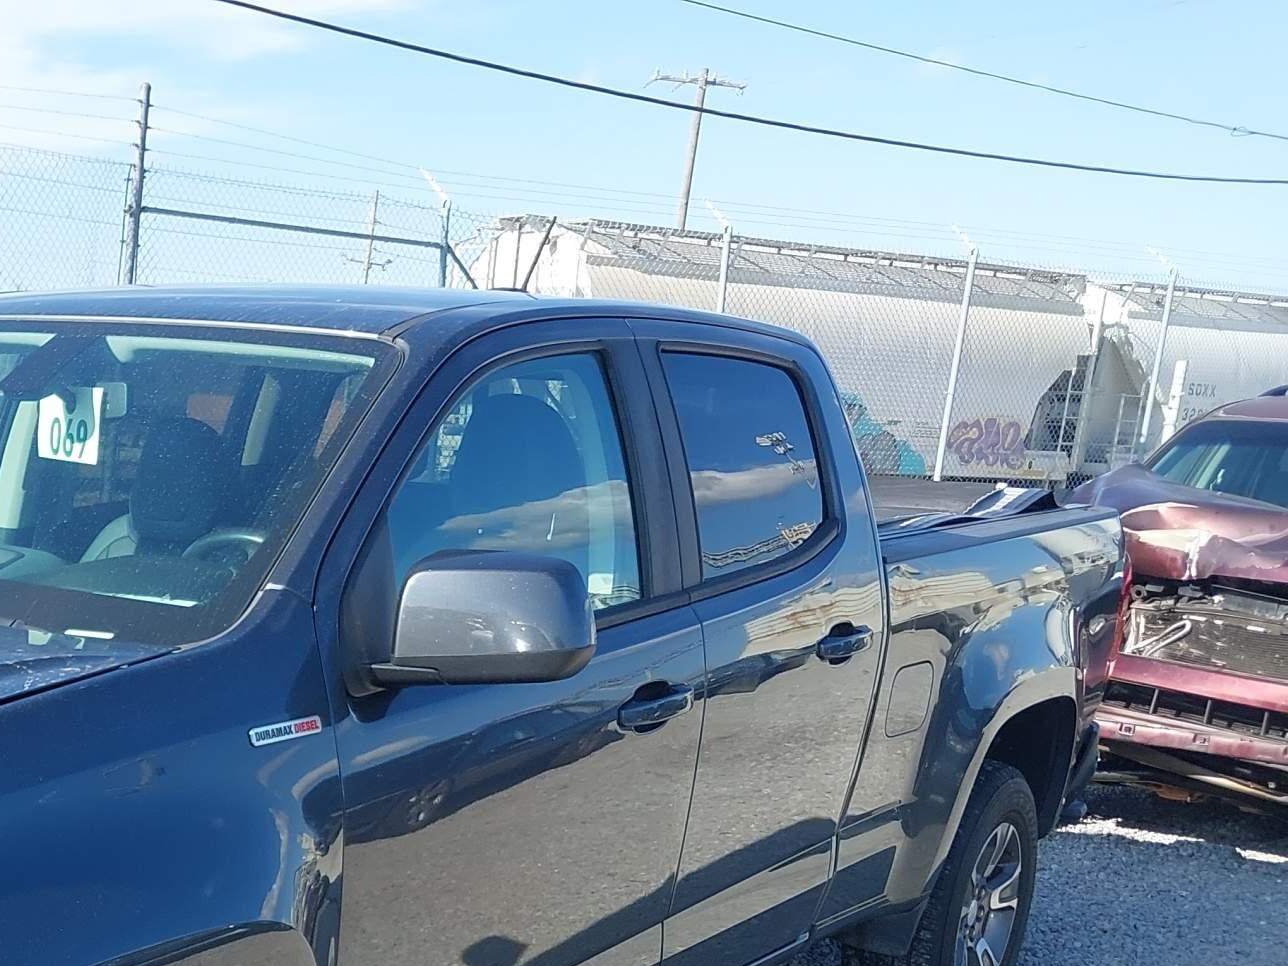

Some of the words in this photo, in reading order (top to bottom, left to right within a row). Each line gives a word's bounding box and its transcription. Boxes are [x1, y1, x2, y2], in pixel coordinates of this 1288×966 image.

[1188, 382, 1216, 397] SOXX
[50, 416, 88, 459] 069
[255, 725, 293, 742] DURAMAX
[294, 720, 319, 733] DIESEL
